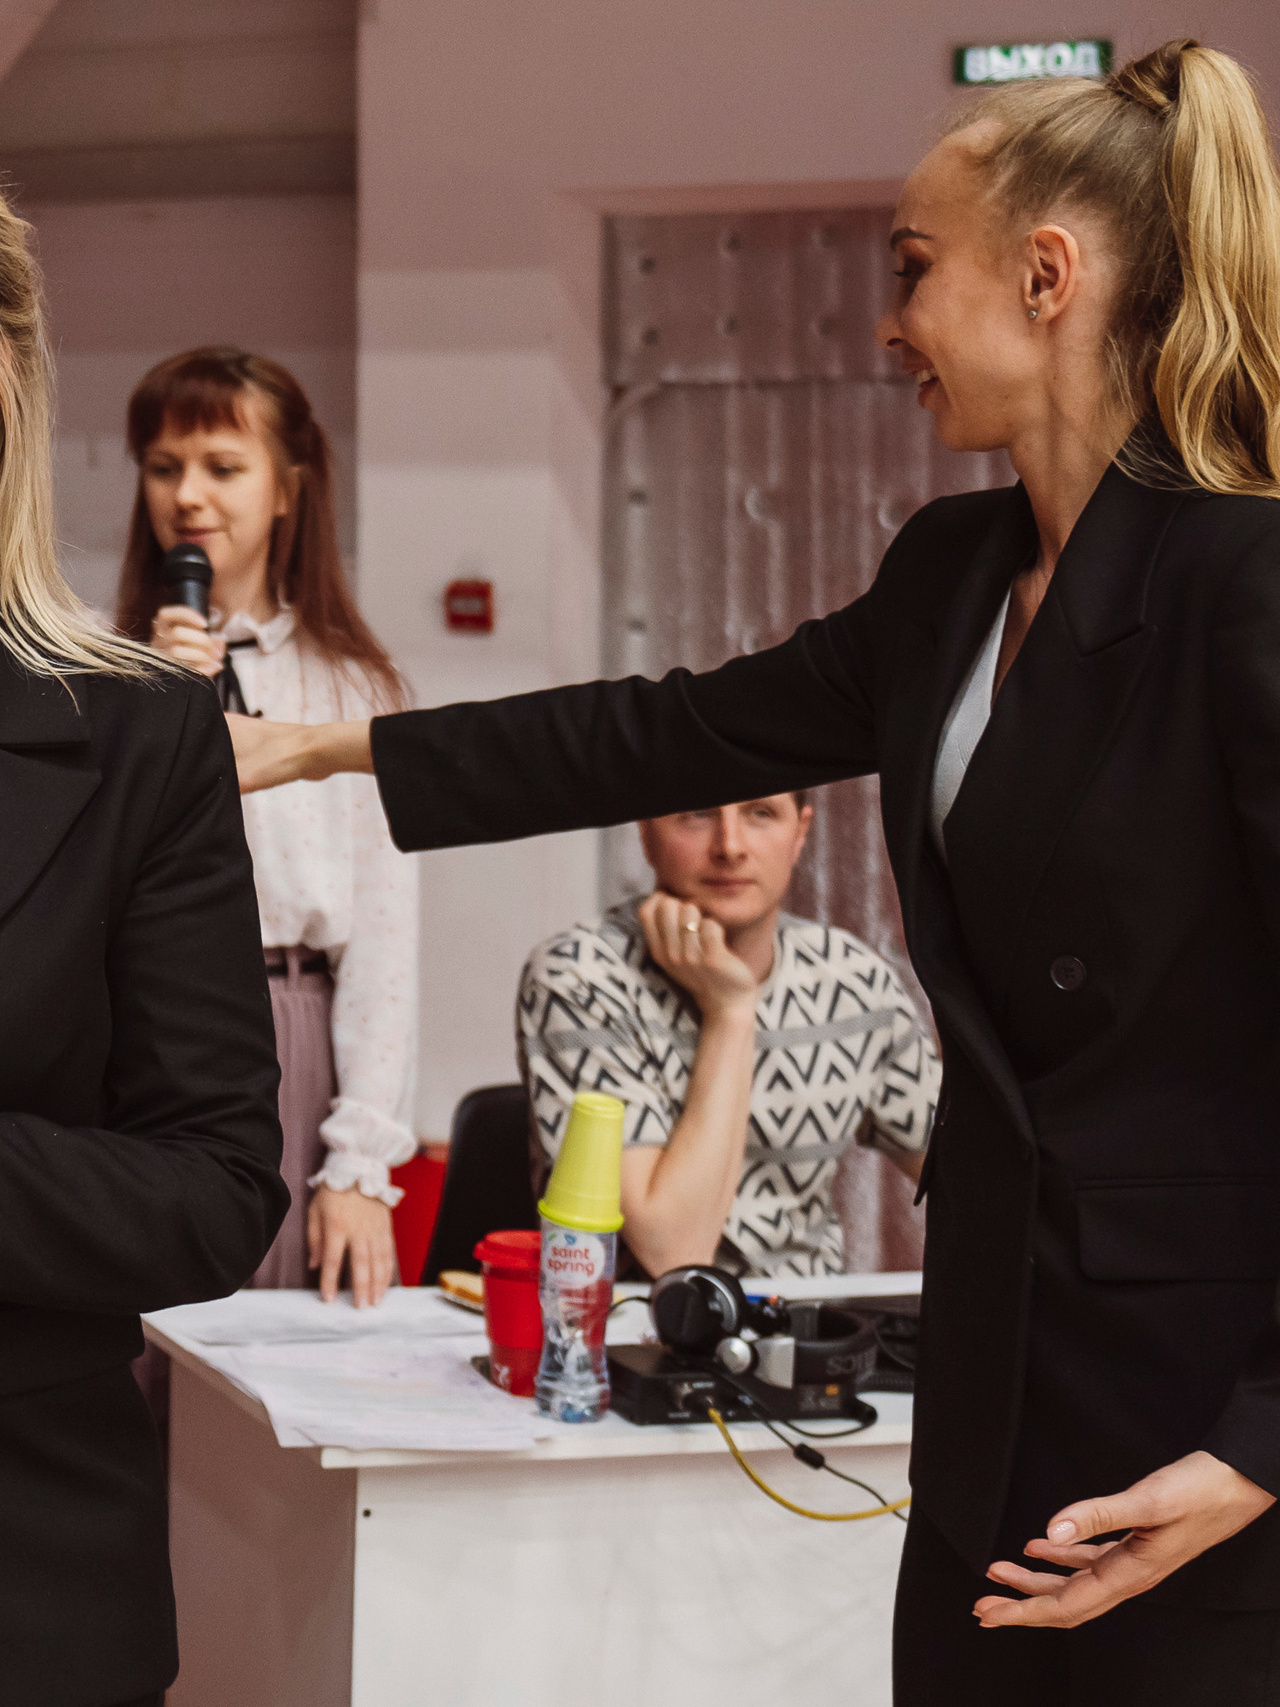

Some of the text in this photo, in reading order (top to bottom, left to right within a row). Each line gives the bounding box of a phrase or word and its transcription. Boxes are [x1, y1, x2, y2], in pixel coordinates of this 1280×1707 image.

[964, 42, 1101, 81] ВЫХОД
[552, 1246, 590, 1260] saint
[547, 1258, 595, 1277] spring
